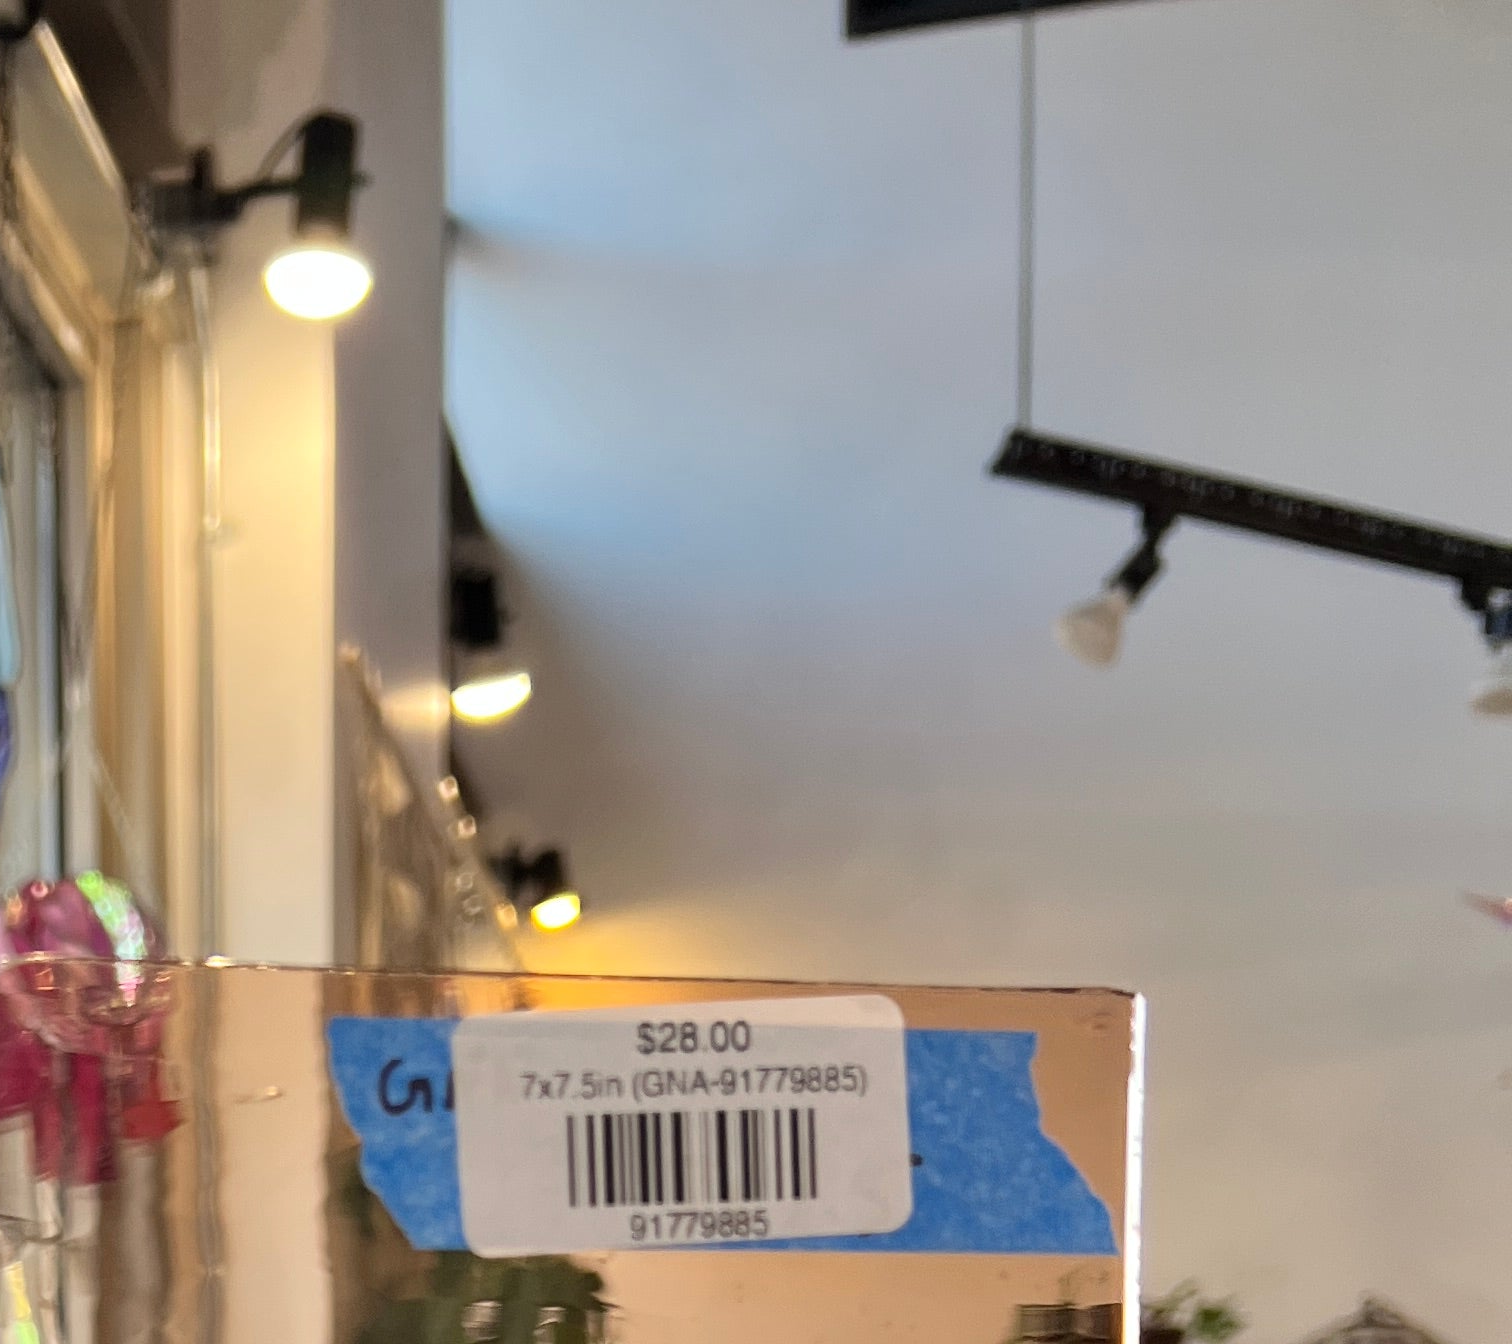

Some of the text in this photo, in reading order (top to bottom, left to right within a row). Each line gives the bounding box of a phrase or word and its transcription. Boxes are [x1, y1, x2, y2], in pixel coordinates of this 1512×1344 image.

[637, 1020, 752, 1055] $28.00
[519, 1063, 869, 1102] 7x7.5in (GNA-91779885)
[629, 1208, 771, 1242] 91779885
